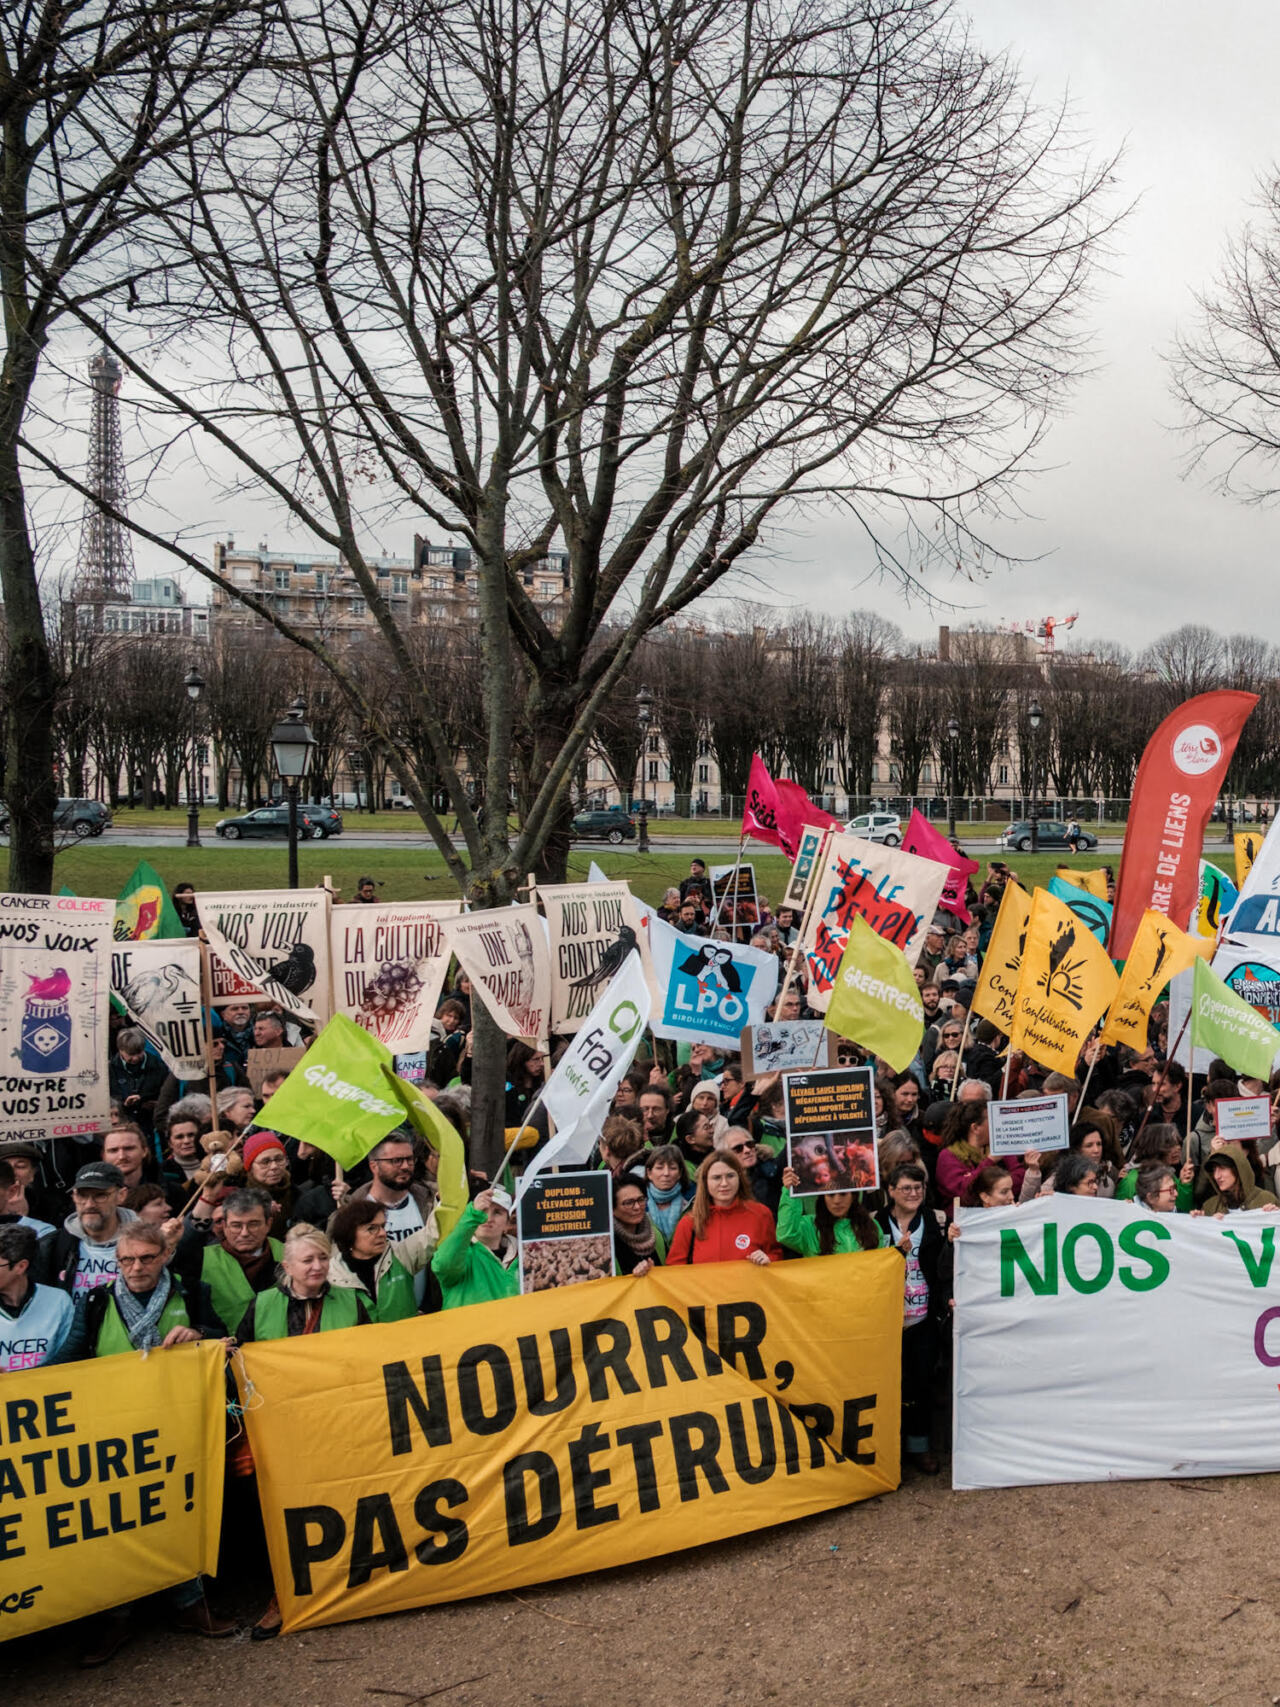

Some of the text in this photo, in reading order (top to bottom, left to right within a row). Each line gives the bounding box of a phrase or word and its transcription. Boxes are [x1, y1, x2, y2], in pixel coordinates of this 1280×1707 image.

[1156, 792, 1191, 877] DE LIENS
[1, 896, 105, 912] CANCER COLERE
[876, 875, 905, 904] LE
[272, 900, 319, 909] industrie
[561, 899, 626, 938] NOS VOIX
[0, 923, 99, 953] NOS VOIX
[217, 912, 308, 950] NOS VOIX
[344, 919, 445, 964] LA CULTURE
[479, 931, 512, 967] UNE
[345, 971, 366, 1007] DU
[674, 982, 744, 1023] LPO
[672, 1013, 708, 1027] BIRDLIFE
[1021, 998, 1080, 1039] Confédération
[398, 1060, 425, 1070] CANCE
[565, 1064, 590, 1097] ciwf.fr
[790, 1086, 816, 1097] ÉLEVAGE
[816, 1086, 836, 1095] SAUCE
[3, 1093, 87, 1116] VOS LOIS
[794, 1110, 864, 1125] DÉPENDANCE VOLONTÉ
[804, 1106, 818, 1114] SOJA
[851, 1102, 858, 1110] ET
[0, 1122, 101, 1142] CANCER COLERE
[536, 1197, 594, 1210] L'ÉLEVAGE SOUS
[544, 1187, 581, 1198] DUPLOMB
[541, 1220, 592, 1233] INDUSTRIELLE
[546, 1210, 587, 1222] PERFUSION
[76, 1257, 119, 1275] CANCE
[1000, 1220, 1171, 1298] NOS
[382, 1301, 795, 1457] NOURRIR,
[284, 1393, 878, 1597] PAS DÉTRUIRE
[46, 1472, 195, 1549] ELLE !
